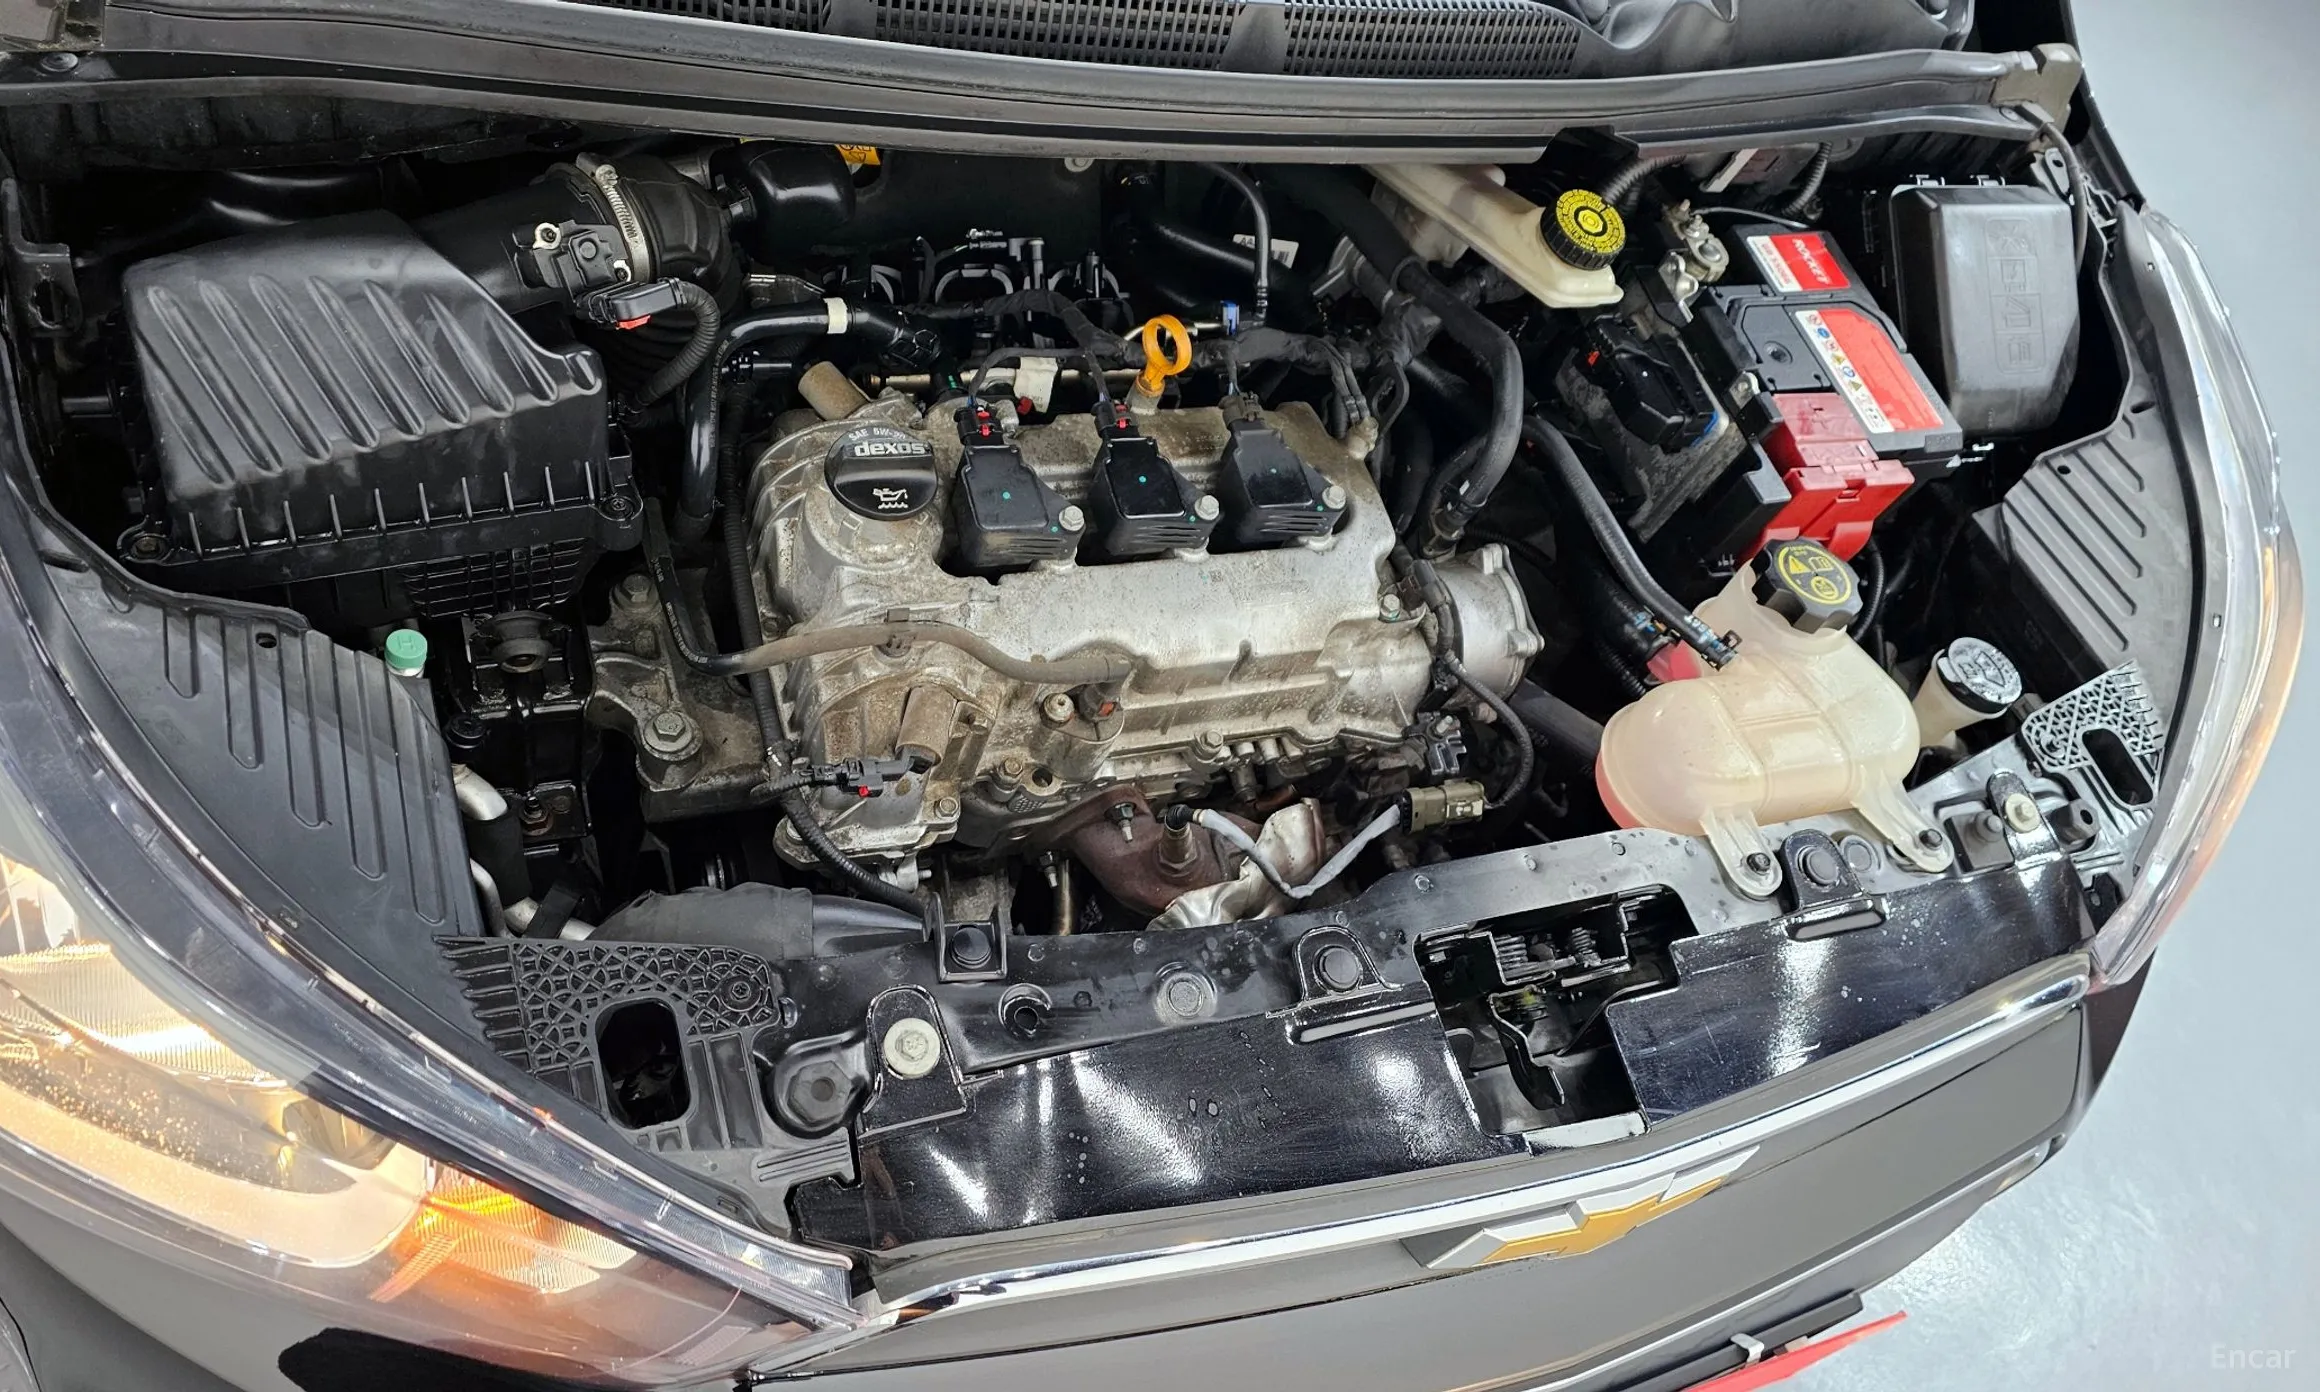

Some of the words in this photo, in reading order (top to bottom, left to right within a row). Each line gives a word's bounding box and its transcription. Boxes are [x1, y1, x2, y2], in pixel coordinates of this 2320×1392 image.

[1792, 237, 1833, 286] ROCKET
[848, 428, 869, 441] SAE
[854, 440, 926, 457] dexos
